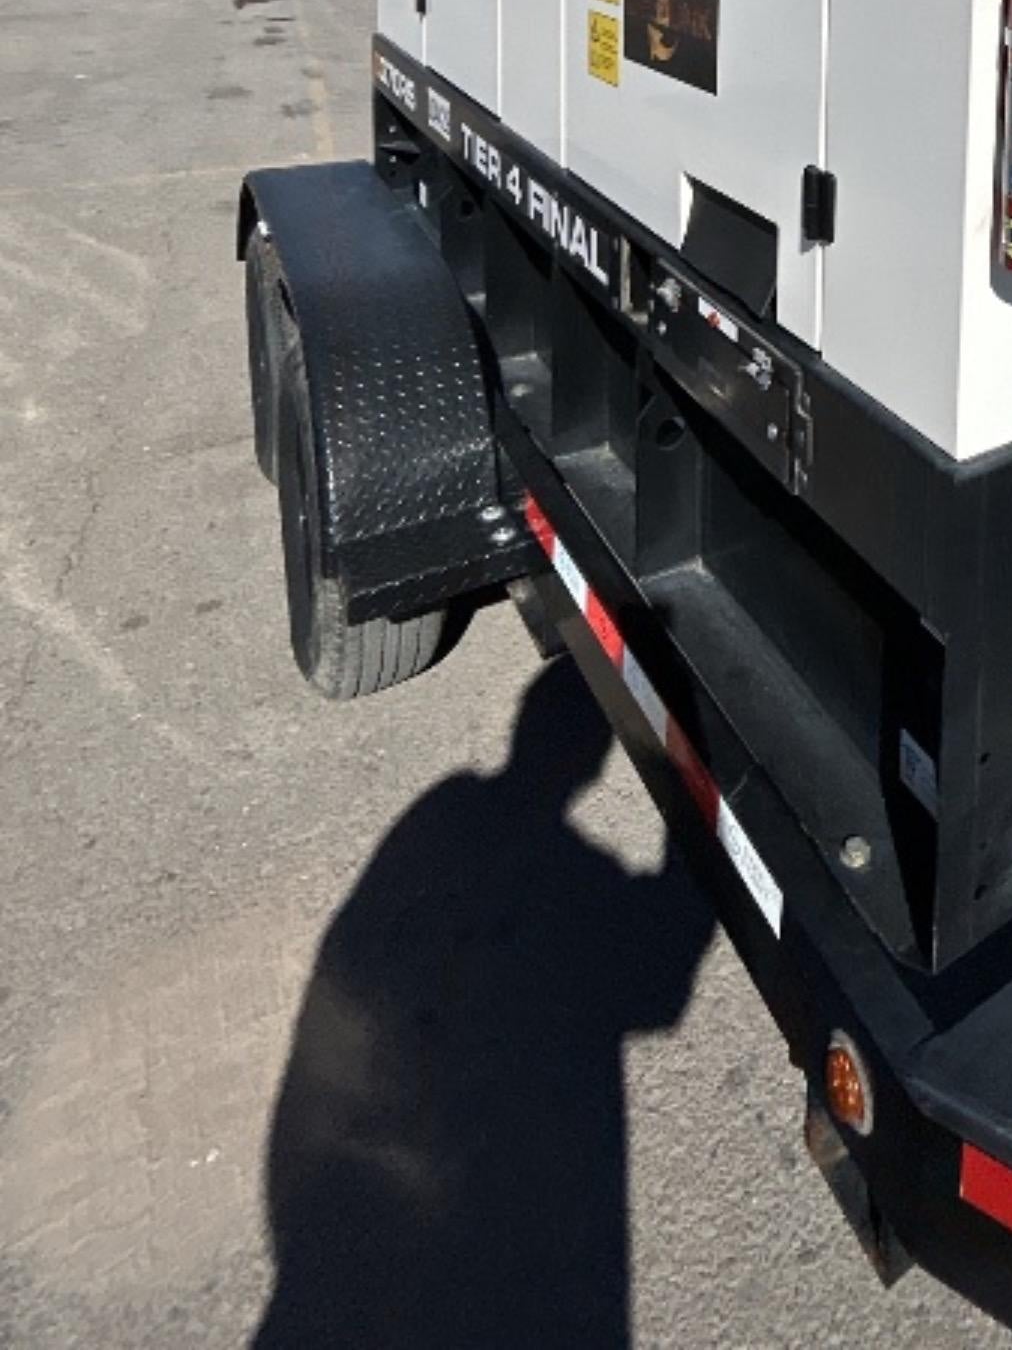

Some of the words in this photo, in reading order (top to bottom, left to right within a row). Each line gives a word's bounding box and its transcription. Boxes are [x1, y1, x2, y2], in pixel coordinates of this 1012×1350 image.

[460, 122, 502, 190] TIER
[505, 163, 522, 206] 4
[527, 176, 609, 287] FINAL
